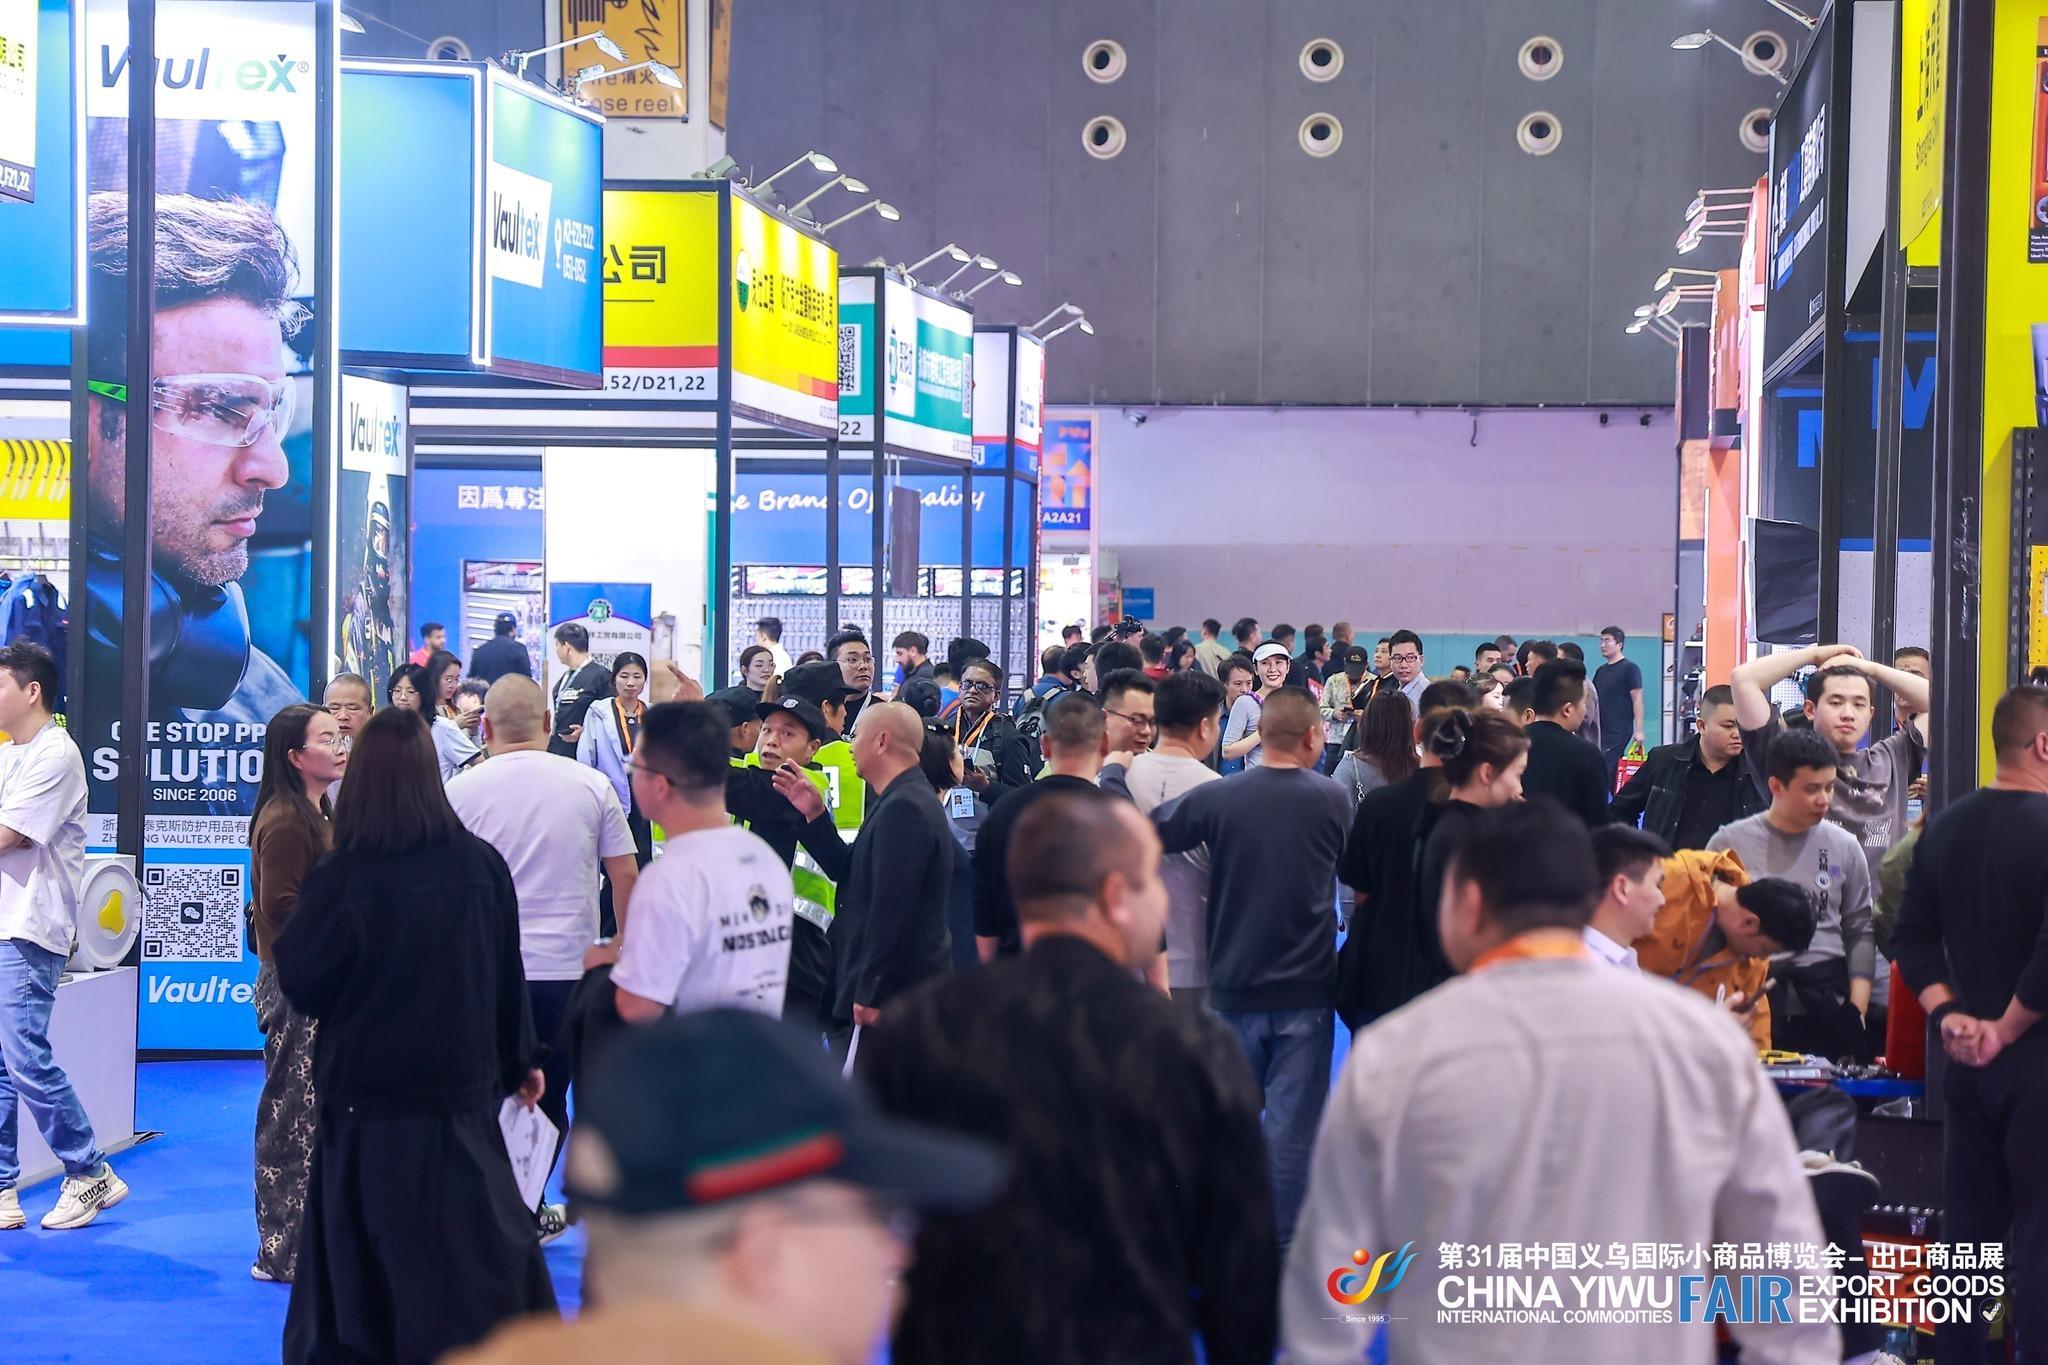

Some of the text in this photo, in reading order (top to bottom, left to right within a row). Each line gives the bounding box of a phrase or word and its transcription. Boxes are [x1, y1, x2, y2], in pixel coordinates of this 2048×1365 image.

[635, 96, 674, 112] reel
[493, 191, 540, 261] Vaultex
[111, 721, 267, 744] OE STOP PP
[92, 747, 264, 783] SLUTIO
[153, 788, 237, 802] SINCE 2006
[163, 834, 212, 844] VAULTEX
[214, 834, 235, 845] PPE
[147, 975, 258, 1004] Vaulte
[78, 1180, 108, 1203] GUCCI
